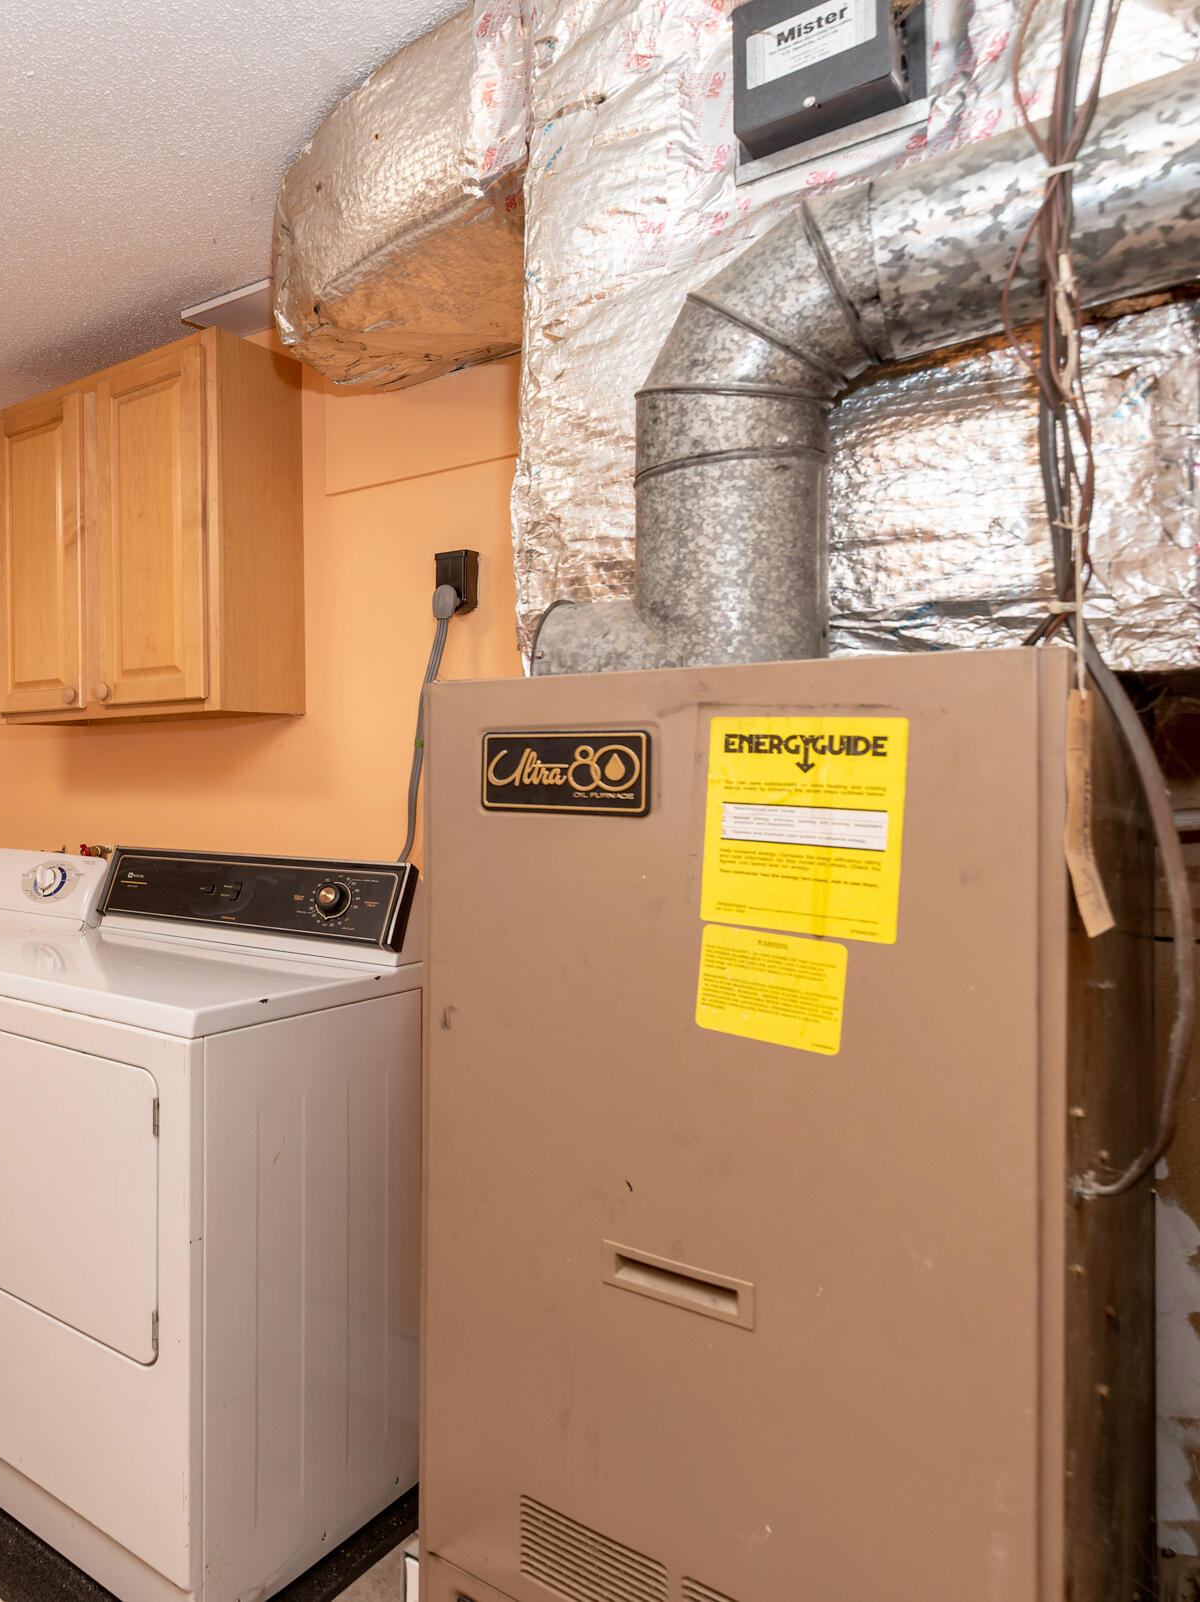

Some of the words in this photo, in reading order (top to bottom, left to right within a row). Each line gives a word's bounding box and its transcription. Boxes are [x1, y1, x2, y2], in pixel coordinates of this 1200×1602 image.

[776, 7, 848, 47] Mister
[724, 733, 888, 757] ENERGYGUIDE
[487, 748, 570, 786] Ultra
[567, 744, 641, 792] 80
[589, 792, 635, 800] FURNACE
